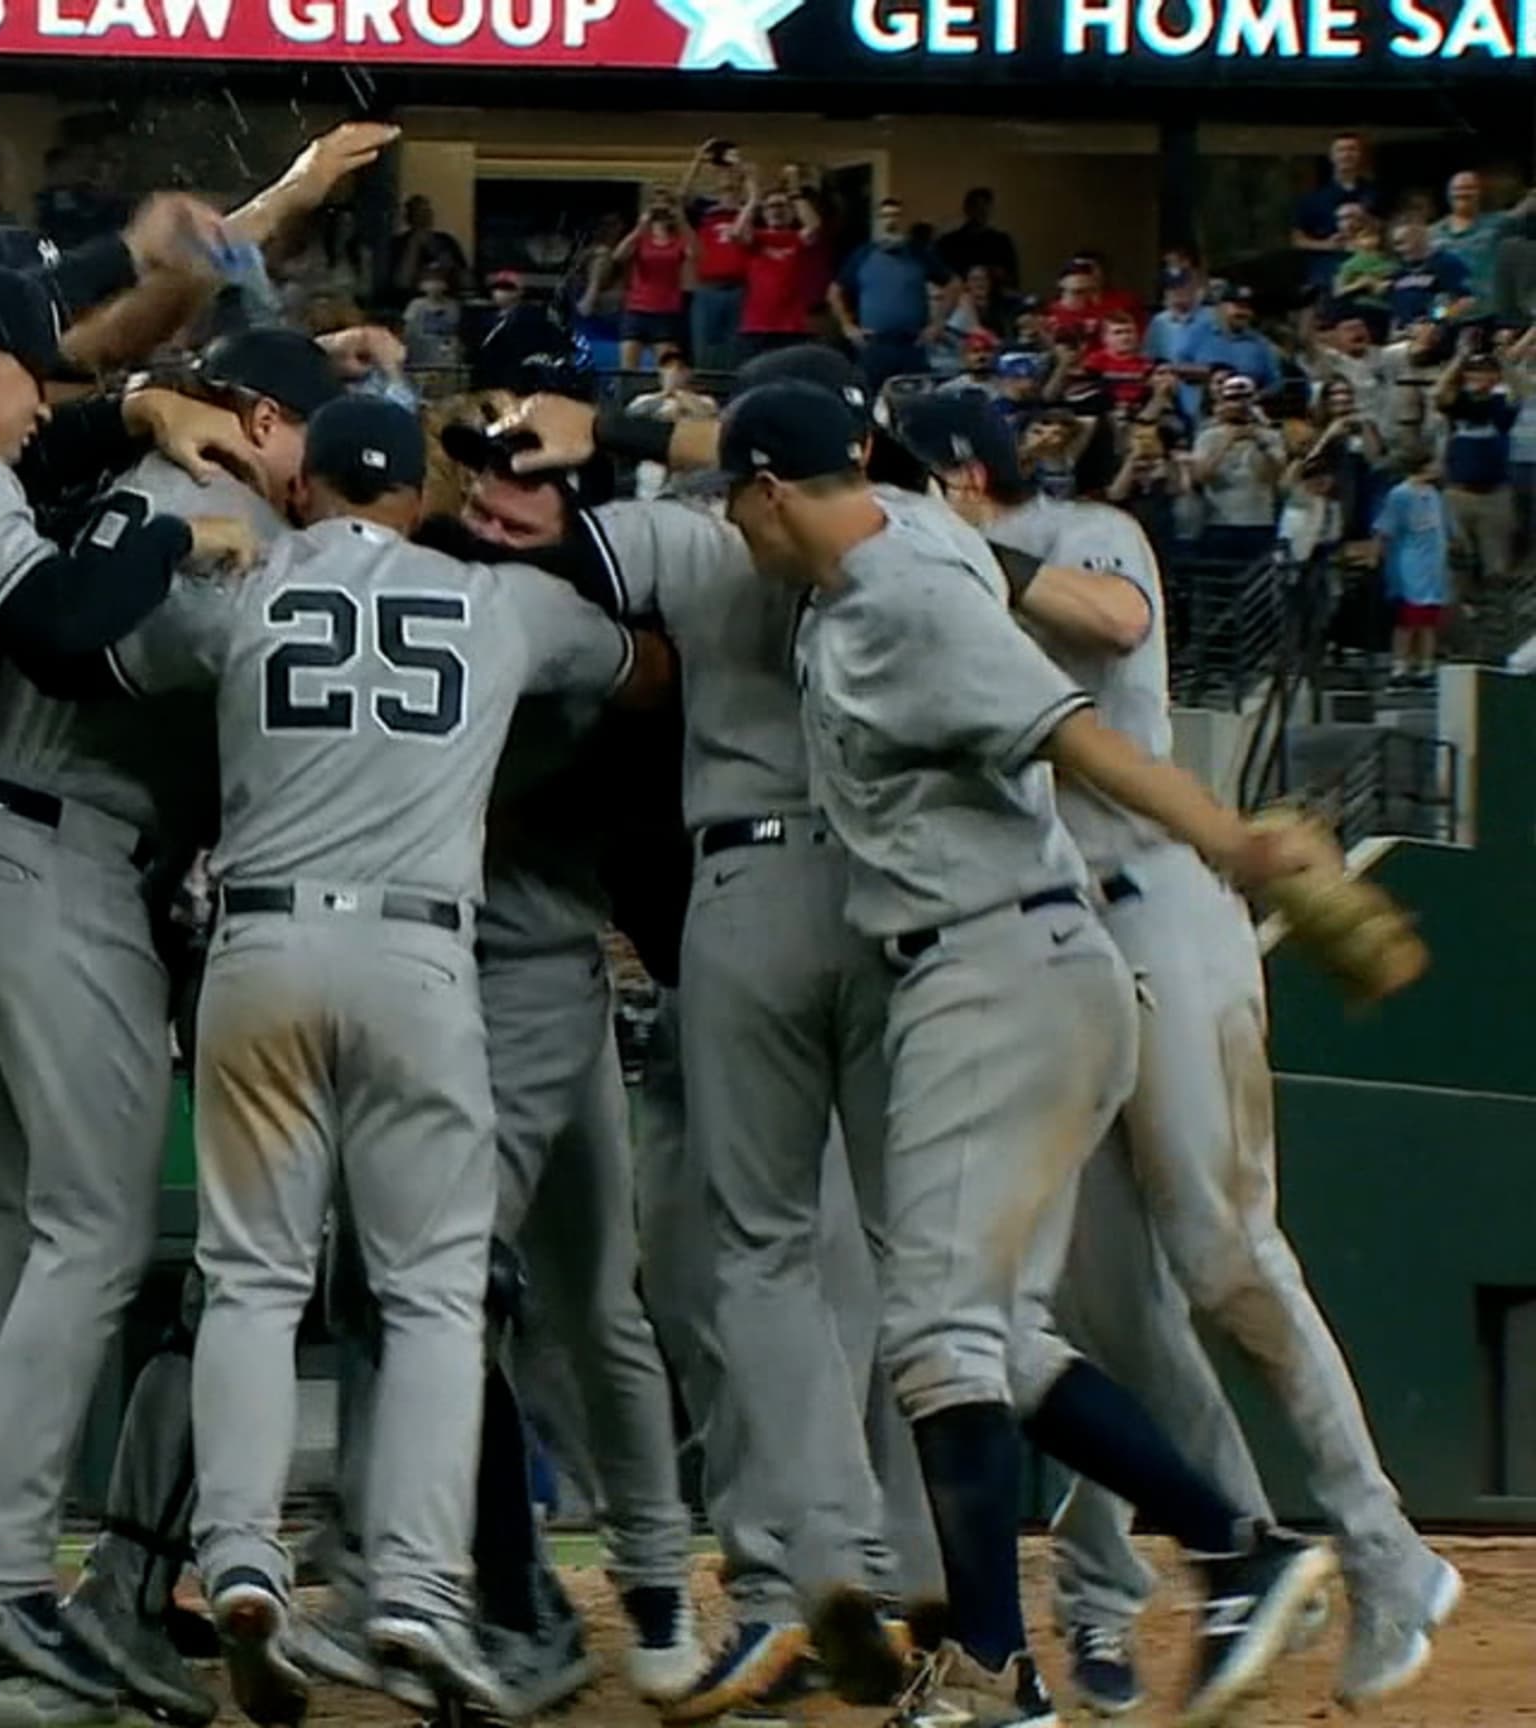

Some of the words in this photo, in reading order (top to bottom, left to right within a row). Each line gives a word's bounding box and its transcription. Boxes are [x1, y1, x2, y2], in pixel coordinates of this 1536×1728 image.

[268, 0, 615, 47] GROUP
[1062, 0, 1363, 57] HOME
[260, 583, 471, 744] 25
